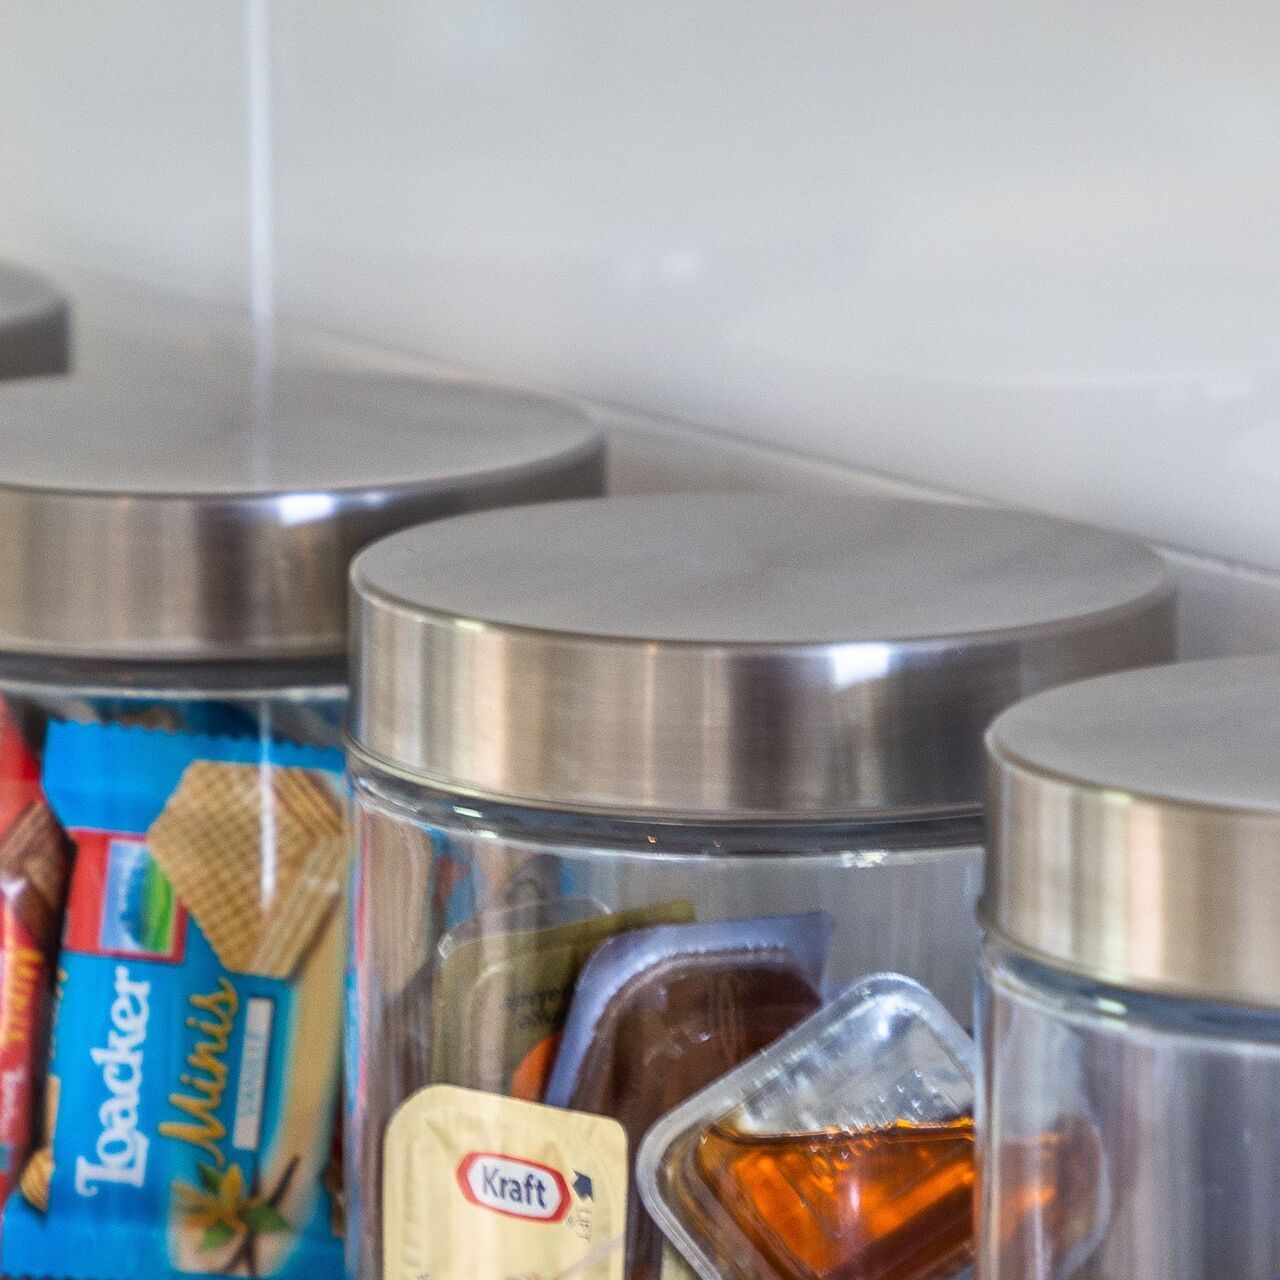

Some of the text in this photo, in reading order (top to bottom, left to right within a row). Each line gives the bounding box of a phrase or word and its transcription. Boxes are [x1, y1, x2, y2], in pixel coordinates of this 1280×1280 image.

[74, 966, 153, 1197] Loacker
[157, 976, 239, 1166] Minis
[481, 1163, 548, 1210] Kraft
